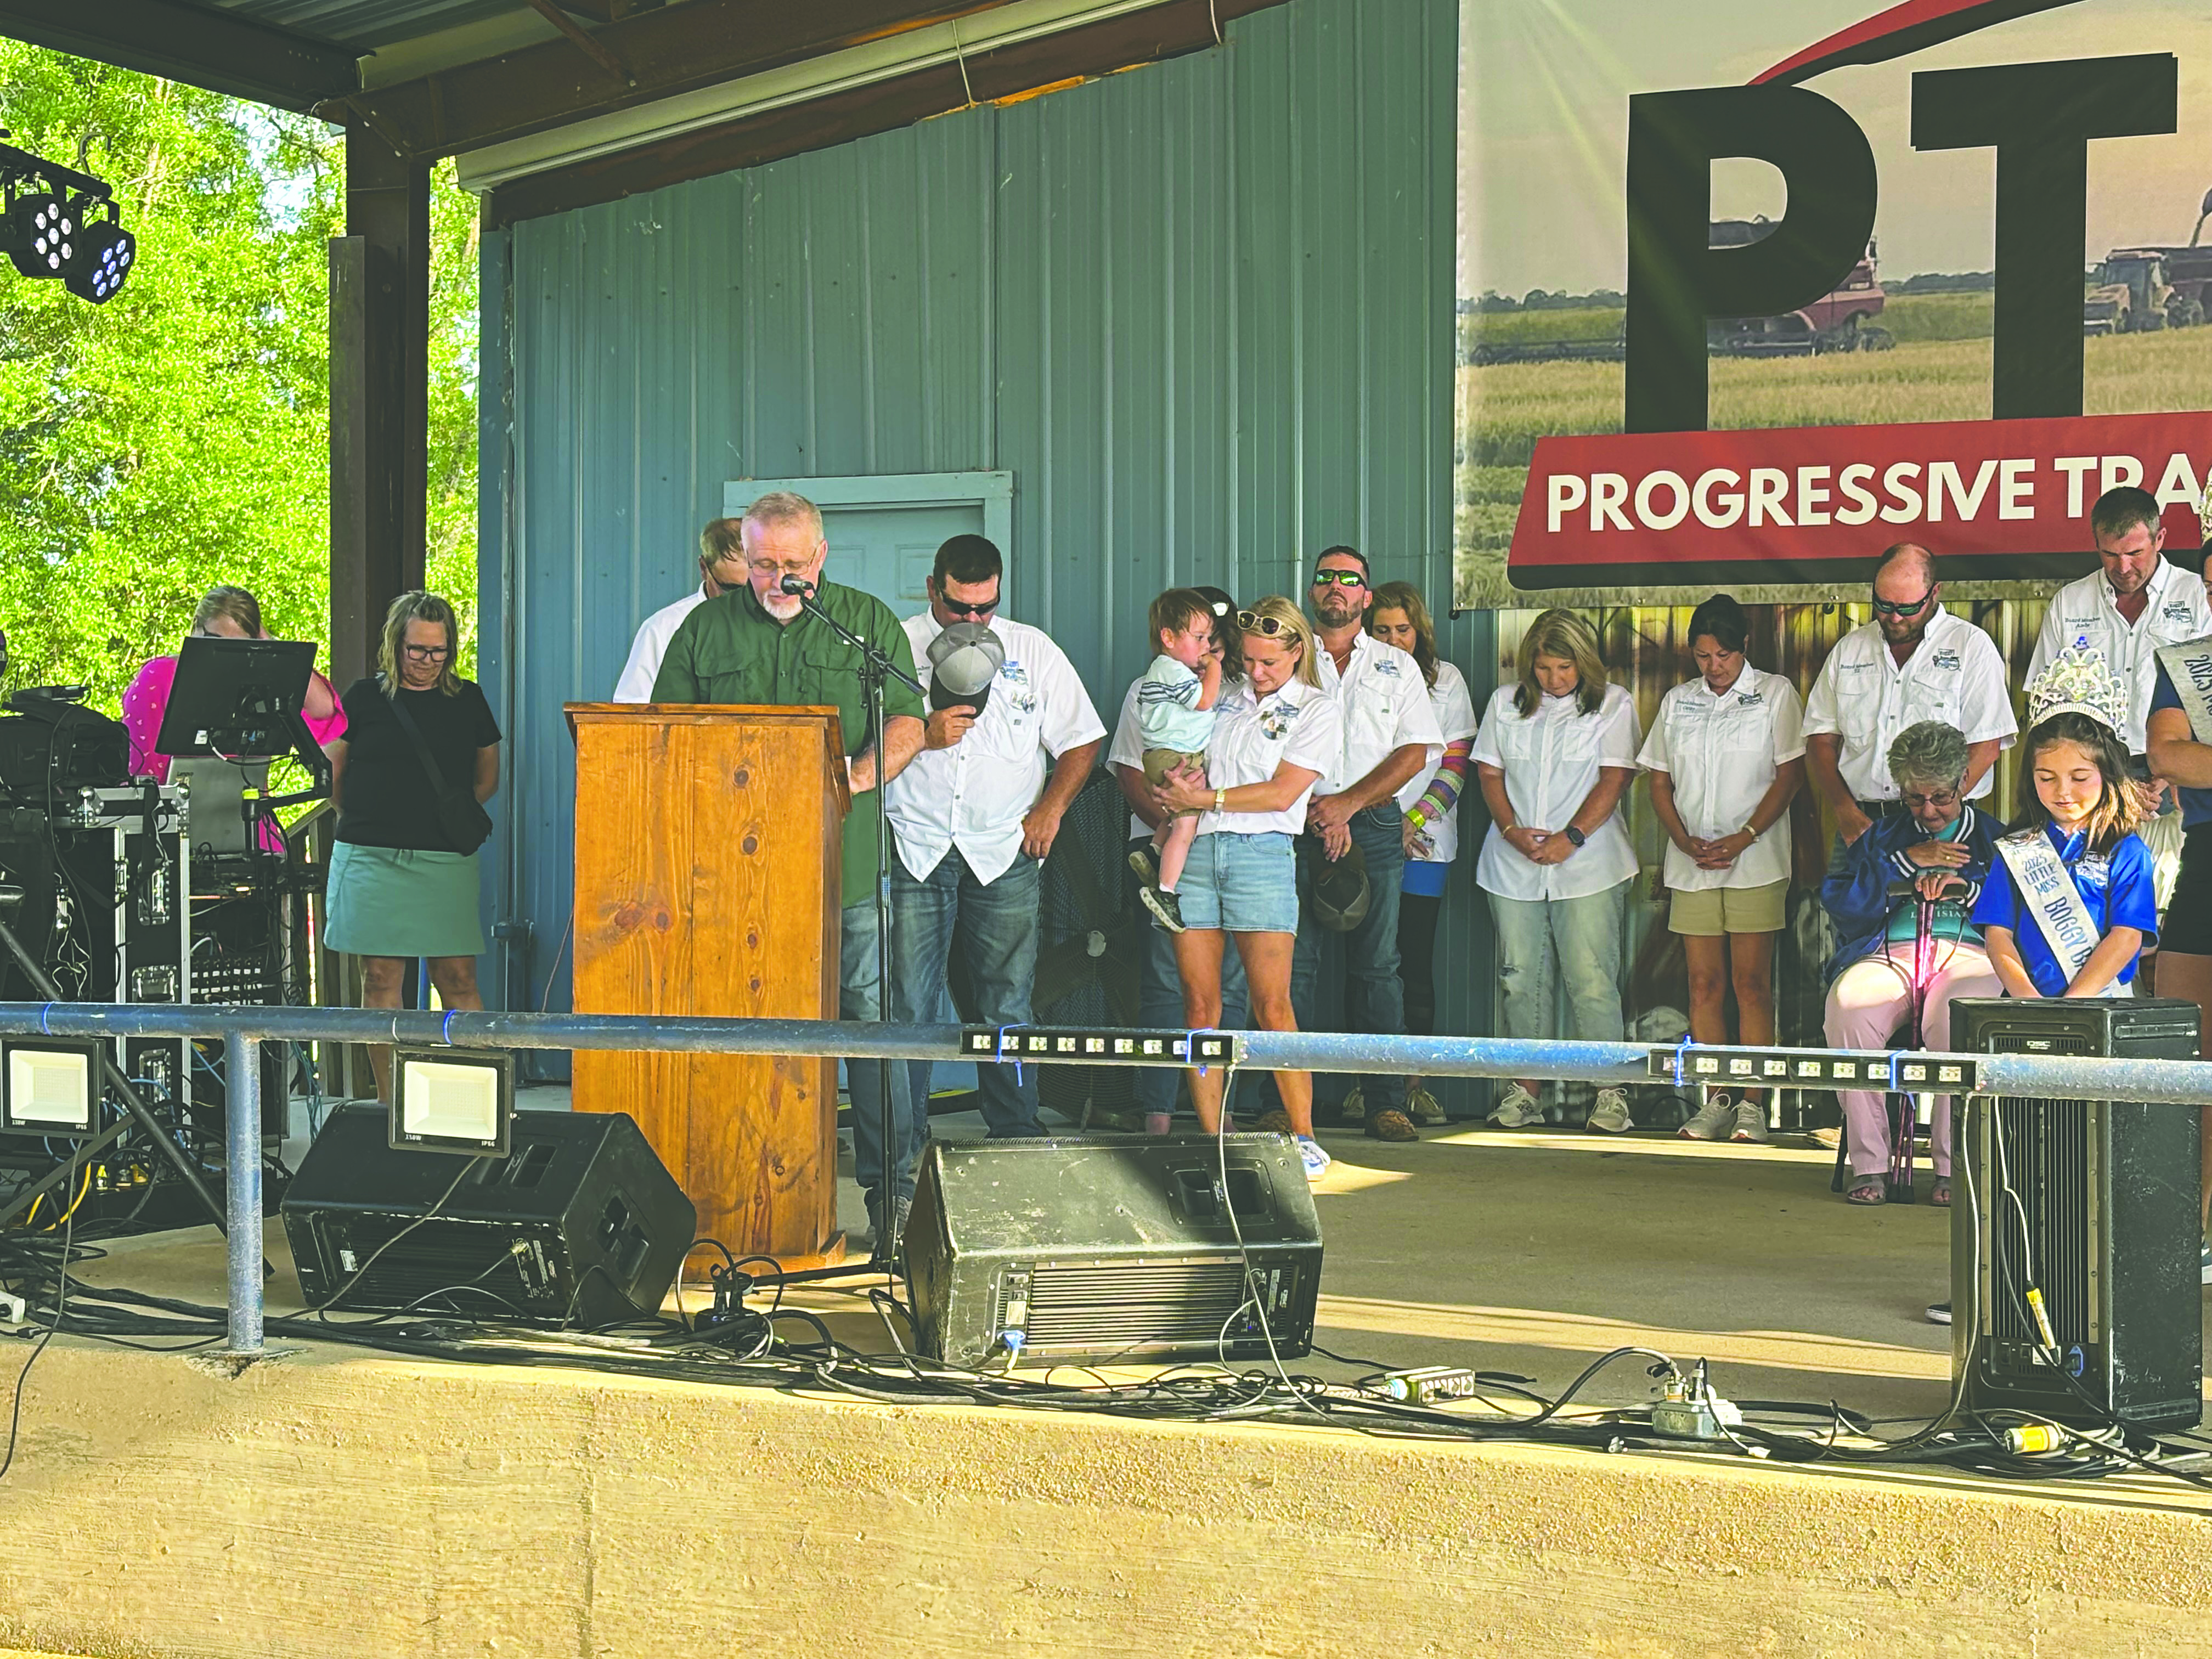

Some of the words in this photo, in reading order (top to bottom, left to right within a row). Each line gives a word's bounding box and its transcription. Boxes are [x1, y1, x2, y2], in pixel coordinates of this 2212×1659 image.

[1548, 459, 2035, 533] PROGRESSIVE
[2054, 454, 2212, 518] TRA
[2021, 854, 2047, 872] 2025
[2023, 862, 2058, 885] LITTLE
[2034, 876, 2059, 896] MISS
[2044, 896, 2089, 949] BOGGY
